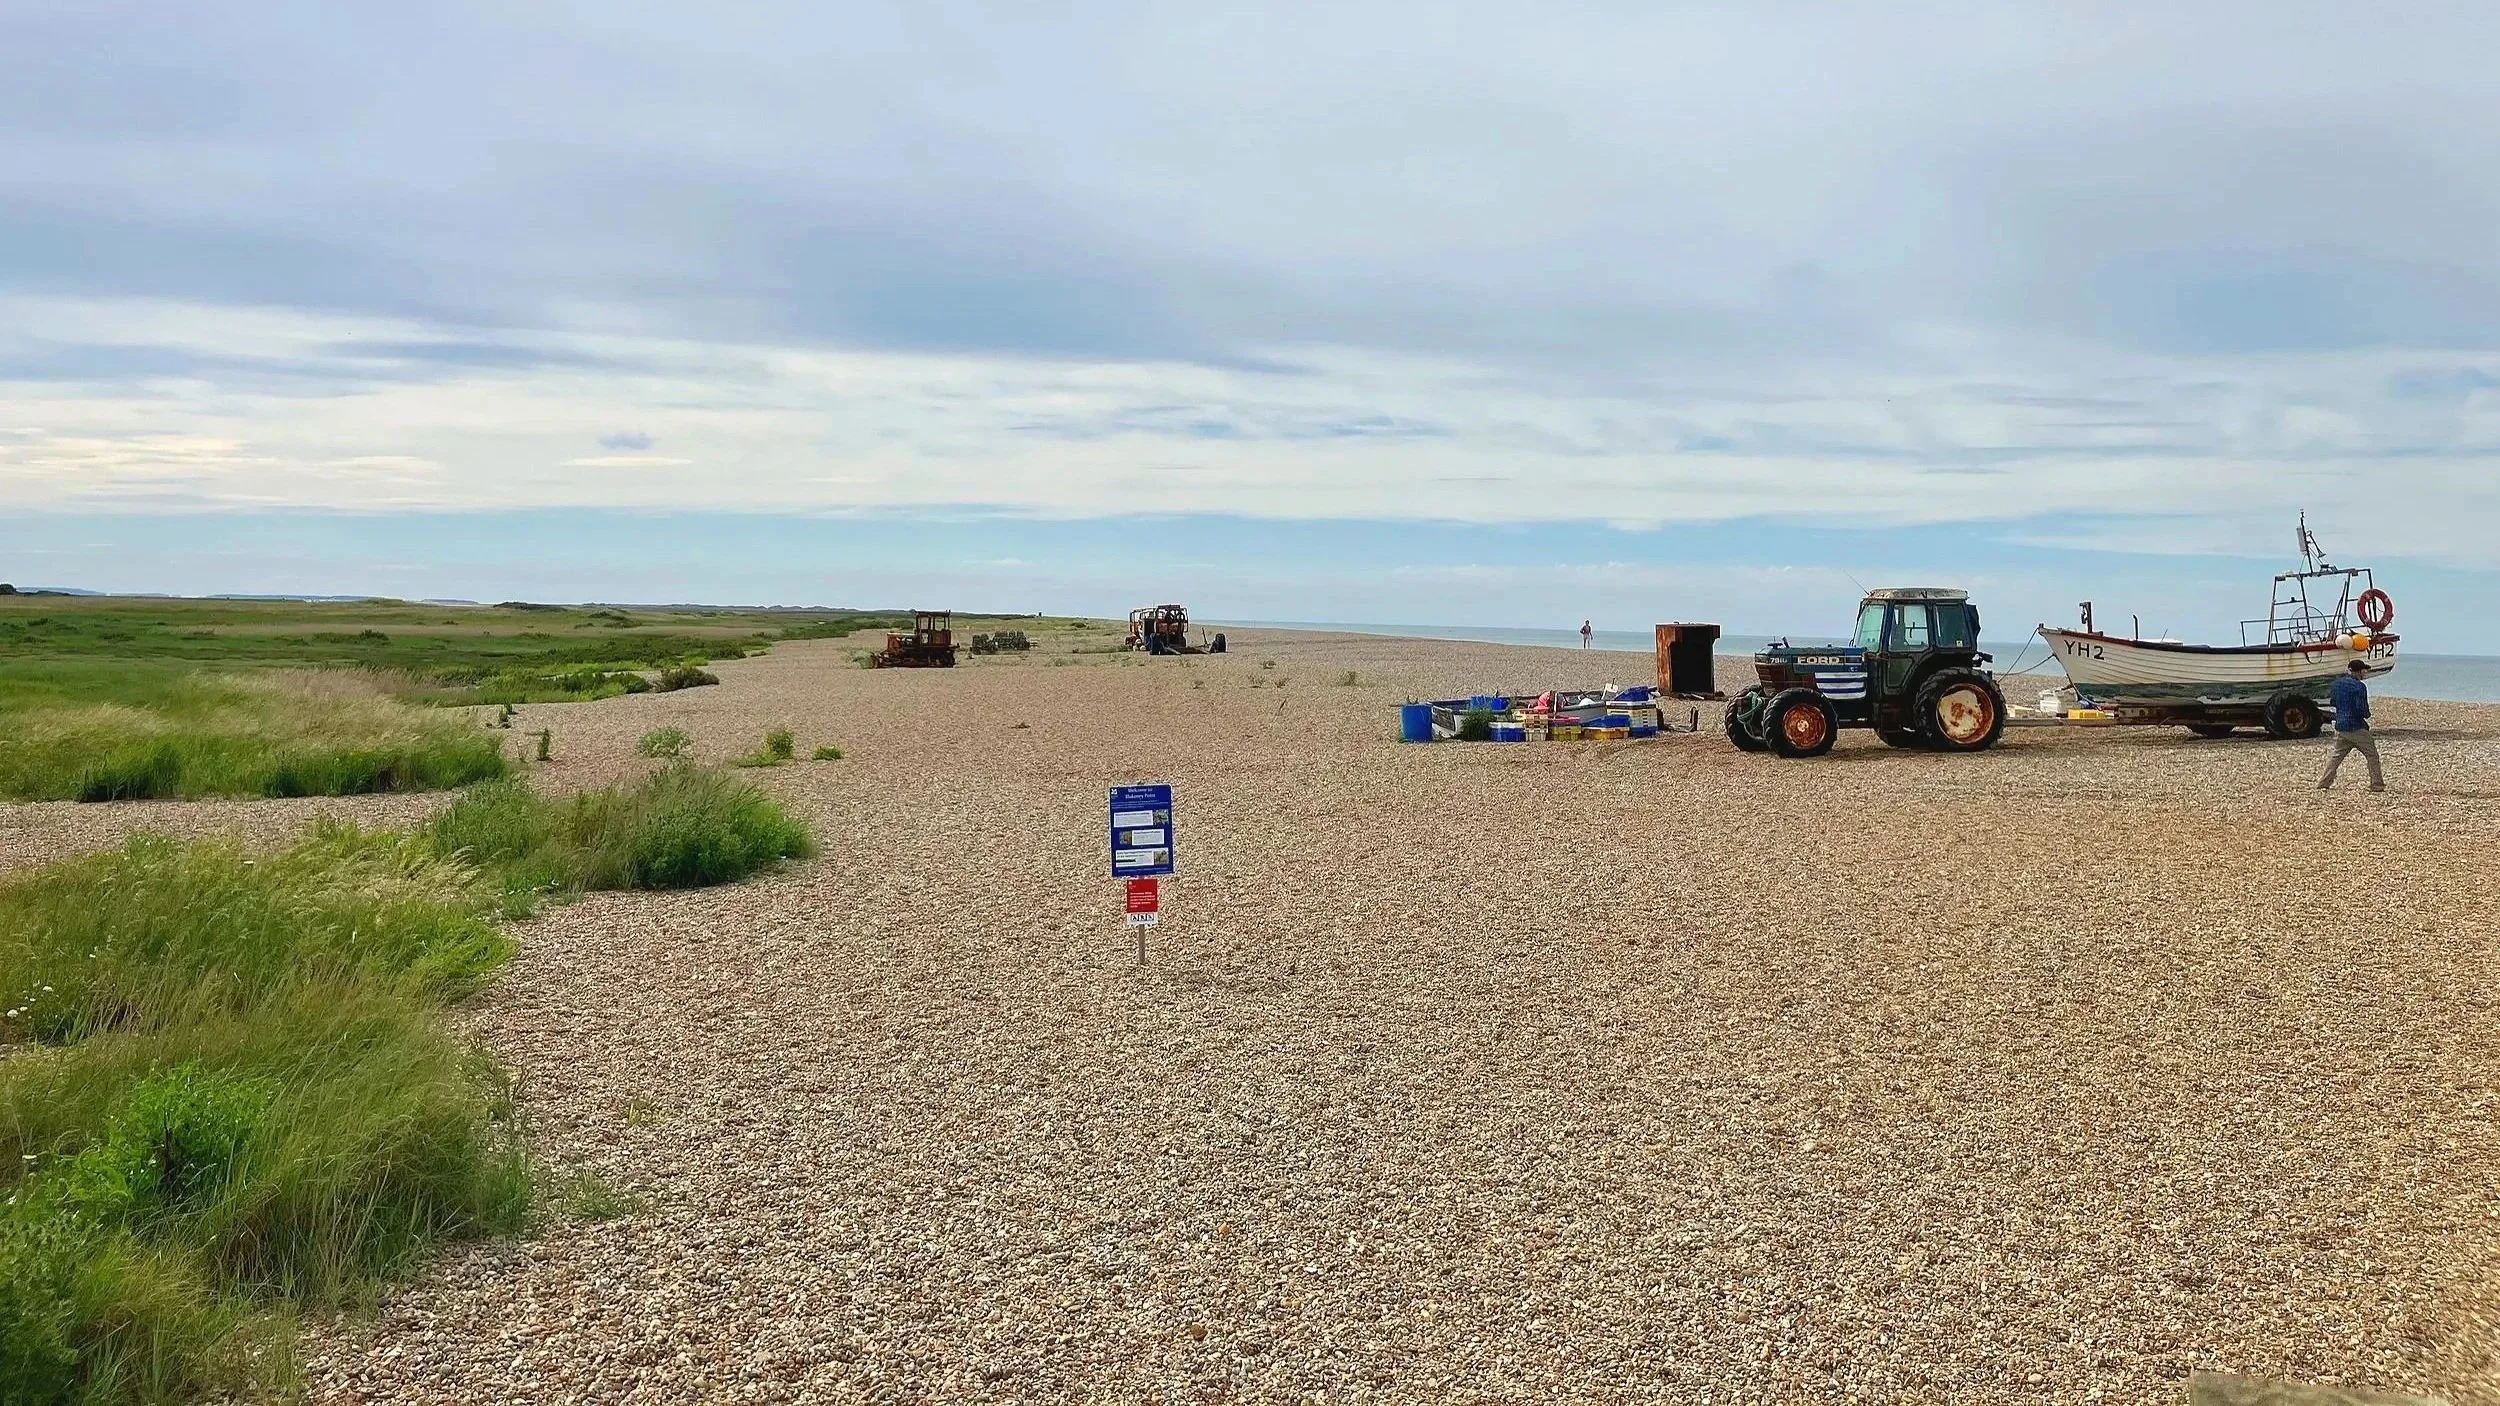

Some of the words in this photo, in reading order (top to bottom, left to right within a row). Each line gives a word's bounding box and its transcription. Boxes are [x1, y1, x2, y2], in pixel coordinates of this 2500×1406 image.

[2064, 640, 2105, 661] YH2
[2366, 642, 2394, 660] YH2
[1797, 656, 1841, 665] FORD
